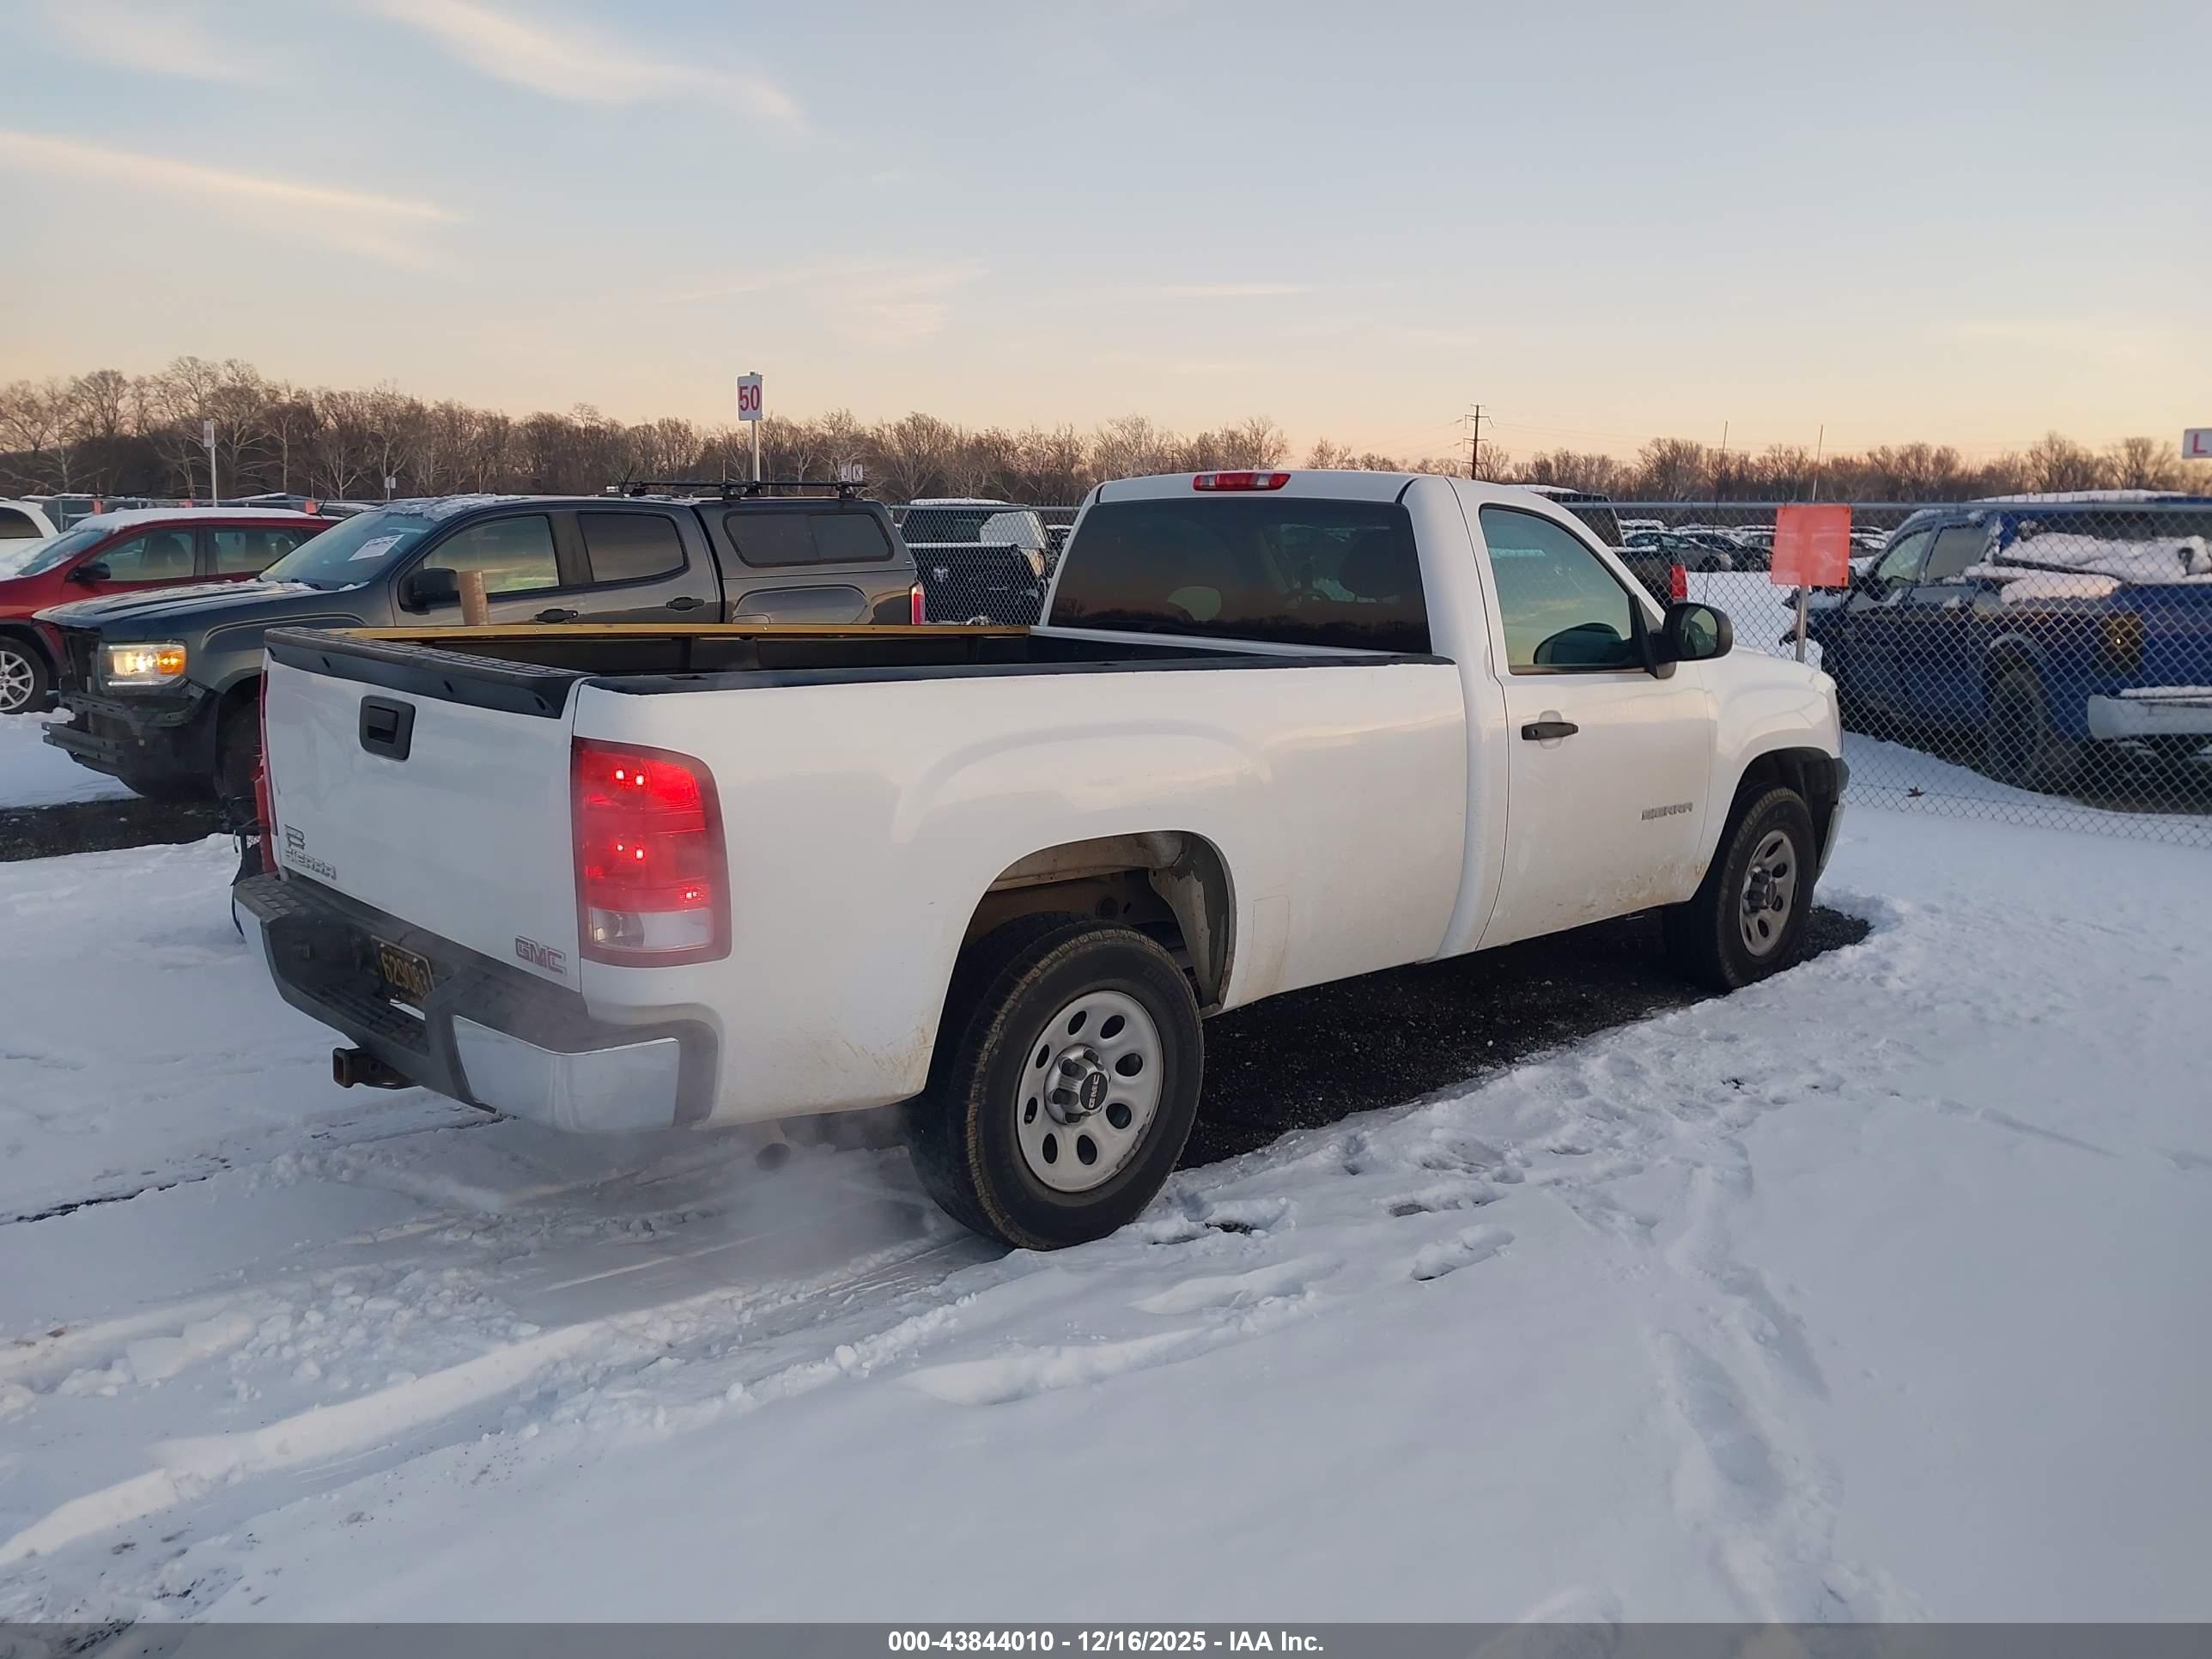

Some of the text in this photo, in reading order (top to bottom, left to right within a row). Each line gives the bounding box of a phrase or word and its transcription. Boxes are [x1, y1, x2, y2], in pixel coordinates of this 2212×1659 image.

[738, 385, 760, 411] 50
[2192, 433, 2208, 453] L
[854, 466, 861, 478] K
[515, 935, 567, 975] GMC
[1088, 1075, 1100, 1109] GMC
